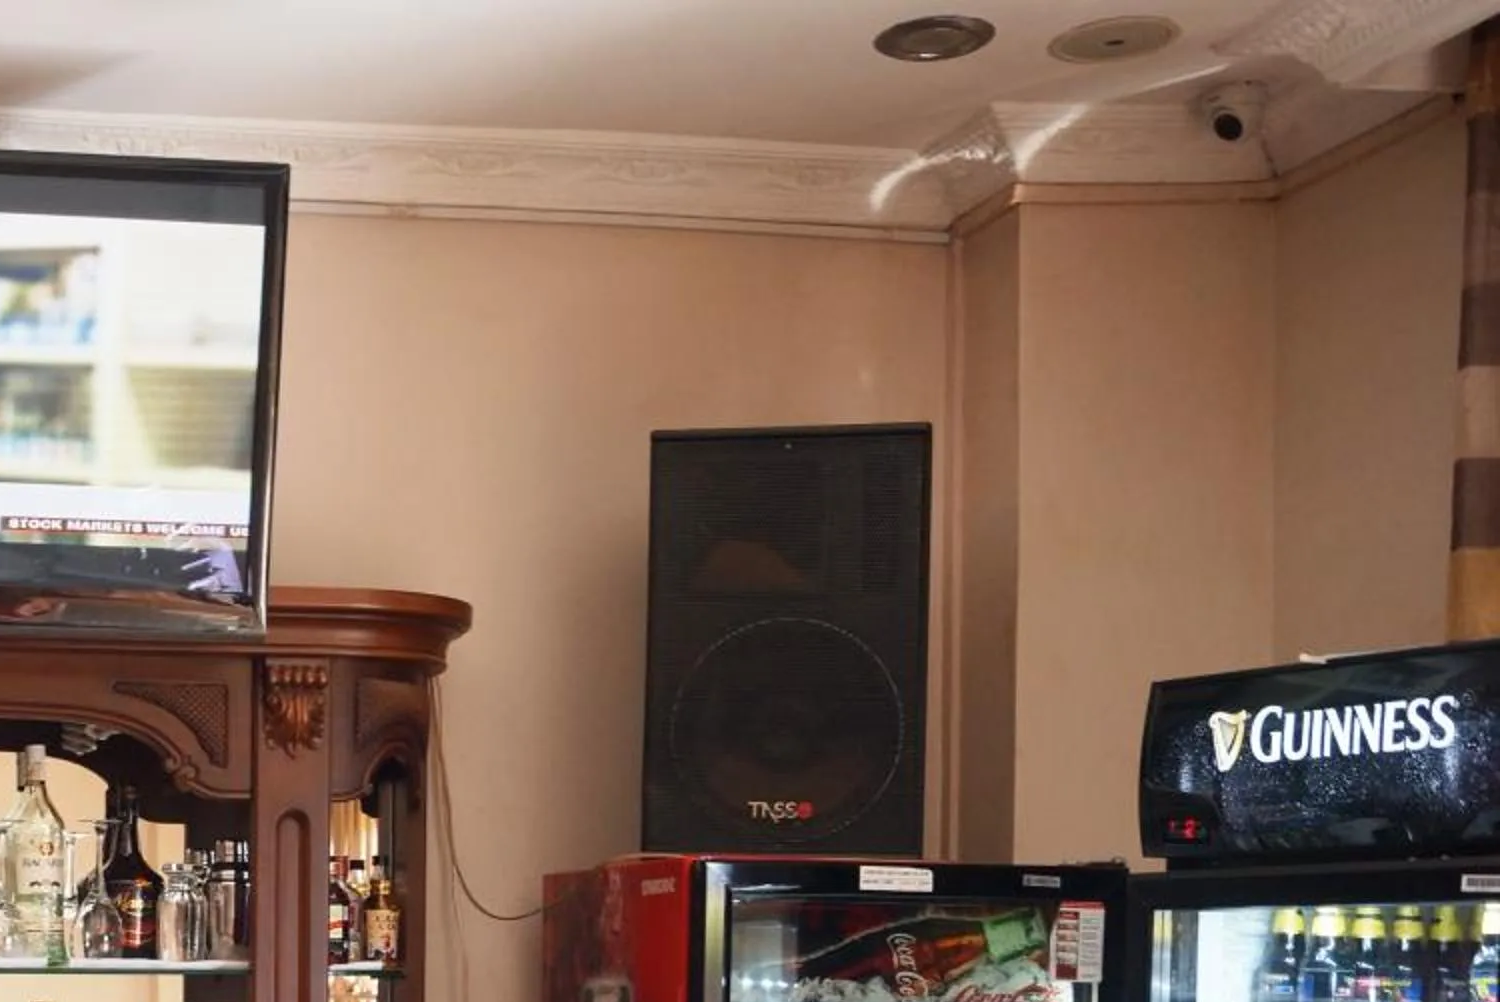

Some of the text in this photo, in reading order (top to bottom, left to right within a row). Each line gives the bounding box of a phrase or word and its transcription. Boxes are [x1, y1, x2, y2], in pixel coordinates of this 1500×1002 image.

[8, 517, 63, 530] STOCK
[65, 519, 143, 533] MARKETS
[1250, 695, 1459, 764] GUINNESS
